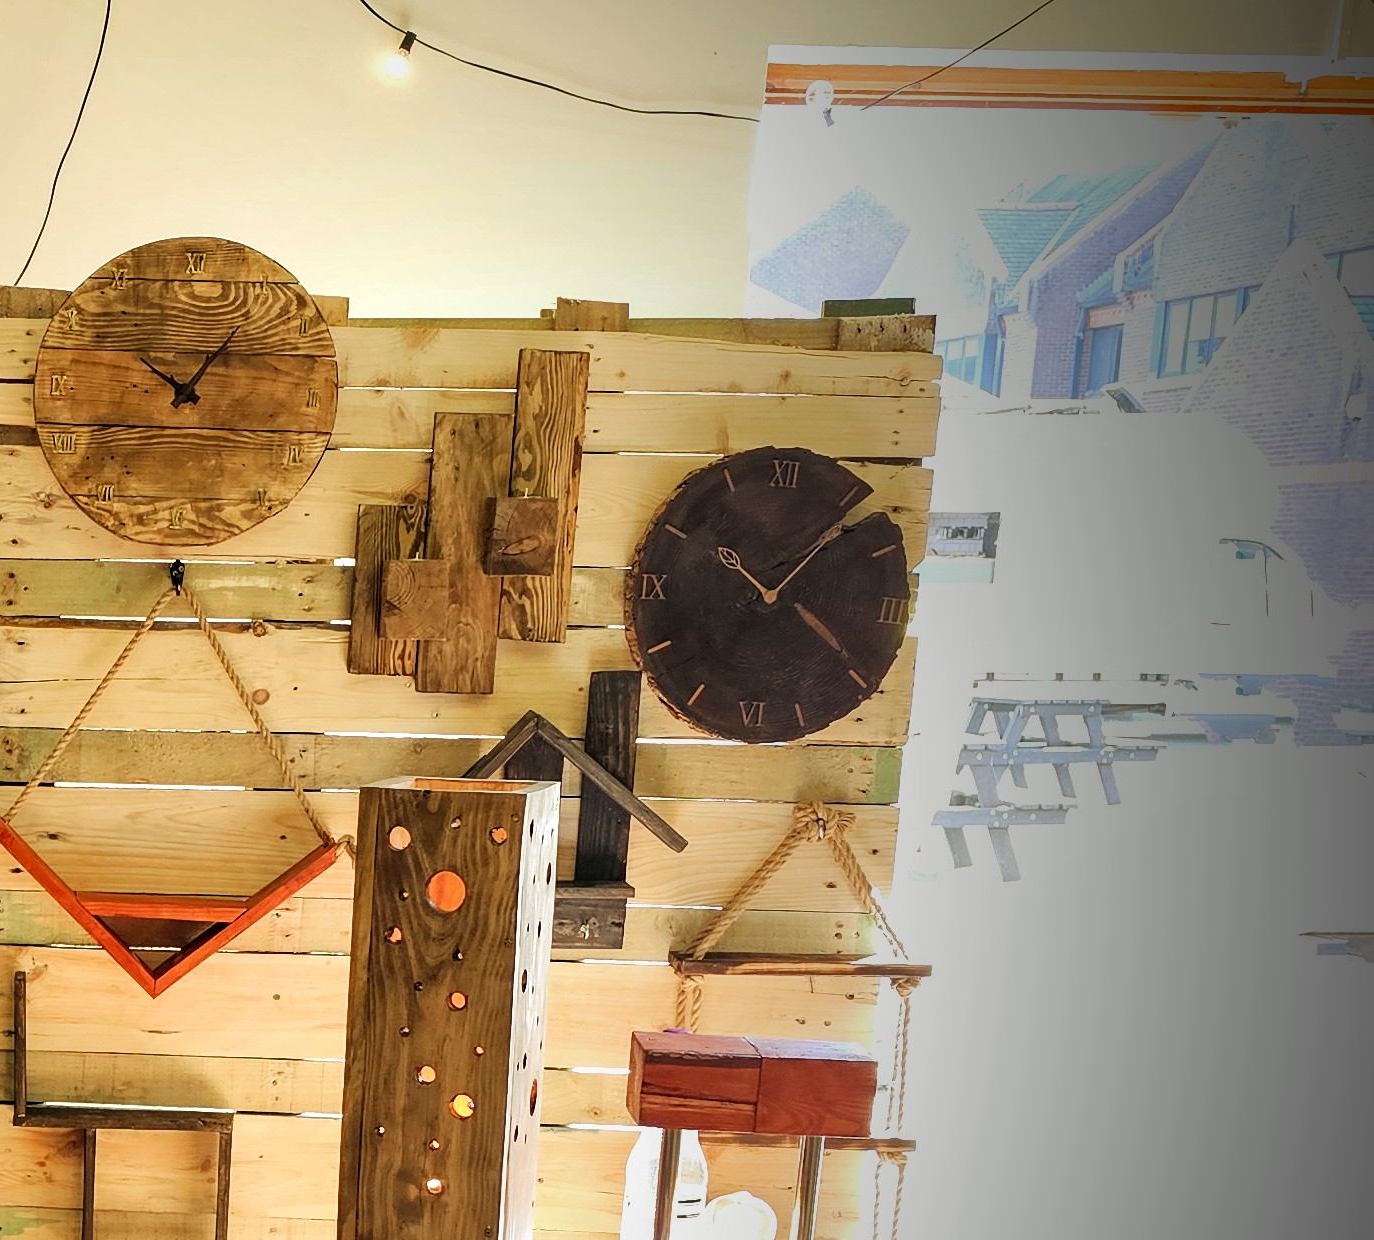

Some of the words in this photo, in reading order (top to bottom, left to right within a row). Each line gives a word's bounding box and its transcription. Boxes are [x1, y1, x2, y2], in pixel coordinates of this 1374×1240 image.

[185, 253, 207, 274] XII
[50, 375, 68, 396] IX
[305, 387, 321, 409] III
[52, 432, 77, 454] VIII
[768, 459, 800, 488] XII
[640, 573, 668, 600] IX
[876, 596, 908, 625] III
[738, 700, 766, 727] VI
